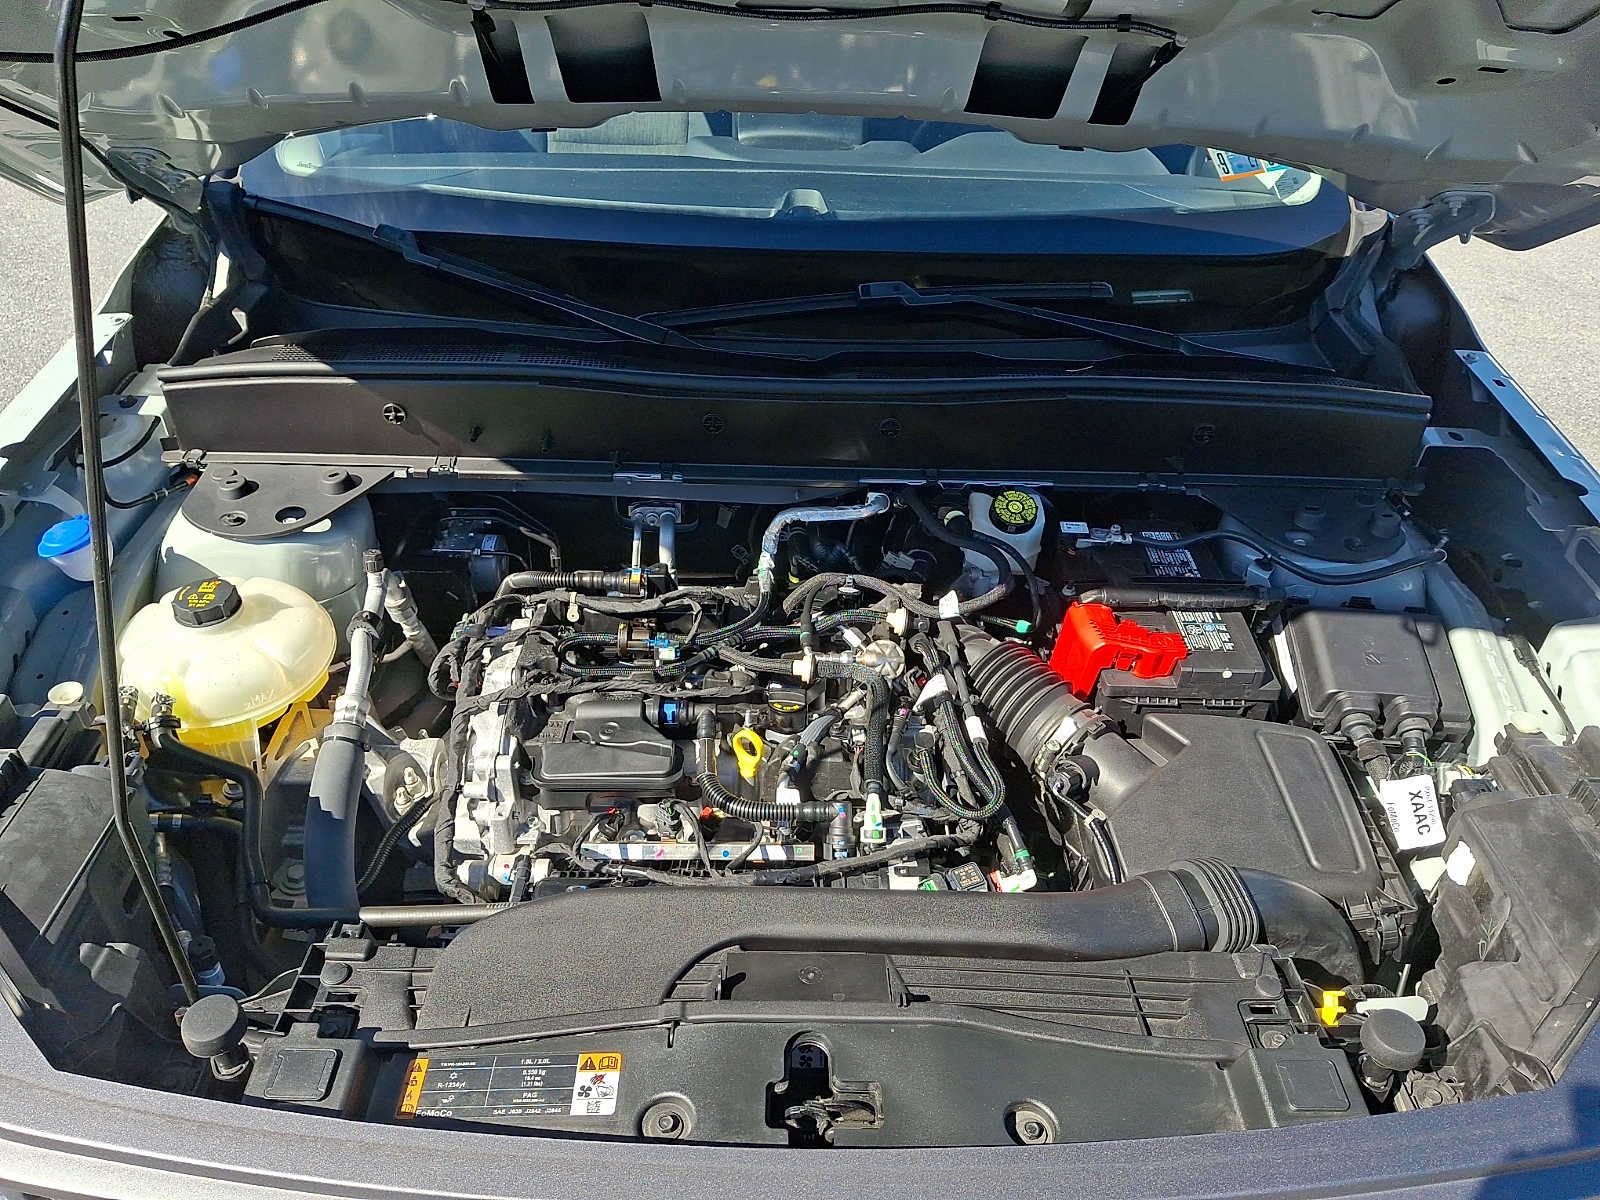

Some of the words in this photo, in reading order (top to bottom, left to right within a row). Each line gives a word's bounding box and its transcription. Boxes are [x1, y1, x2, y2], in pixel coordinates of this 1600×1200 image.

[1217, 153, 1230, 174] 9
[1408, 790, 1431, 836] XAAC
[416, 1109, 453, 1118] FoMoCo
